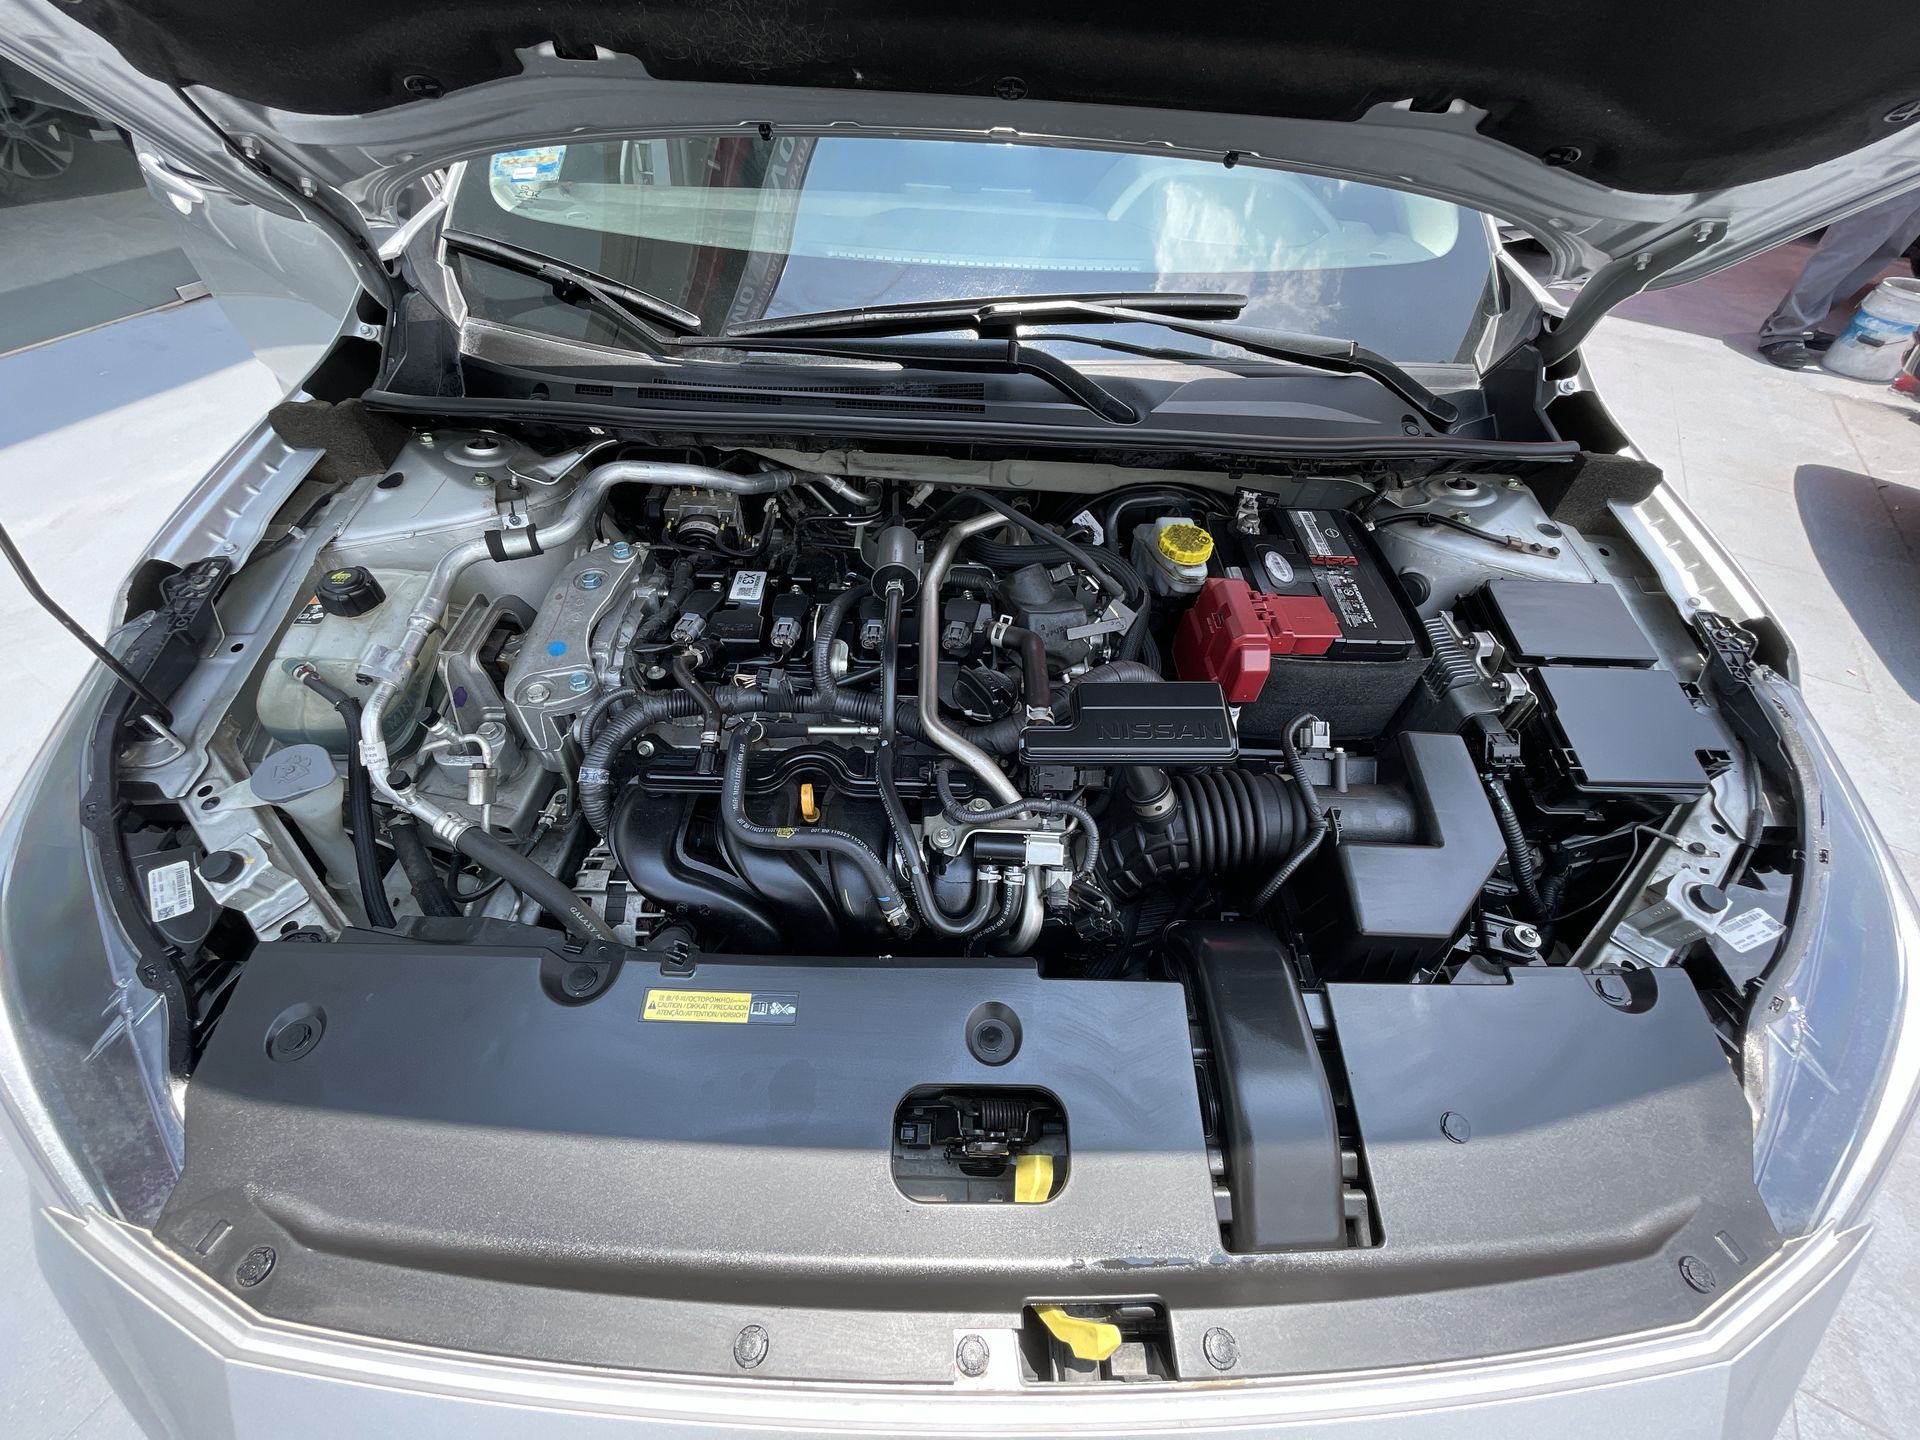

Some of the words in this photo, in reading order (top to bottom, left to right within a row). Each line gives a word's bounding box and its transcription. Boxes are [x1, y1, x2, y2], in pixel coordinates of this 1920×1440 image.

[742, 573, 757, 585] X3
[1097, 721, 1224, 740] NISSAN
[570, 906, 598, 932] GALAXY
[657, 1001, 683, 1009] CAUTION
